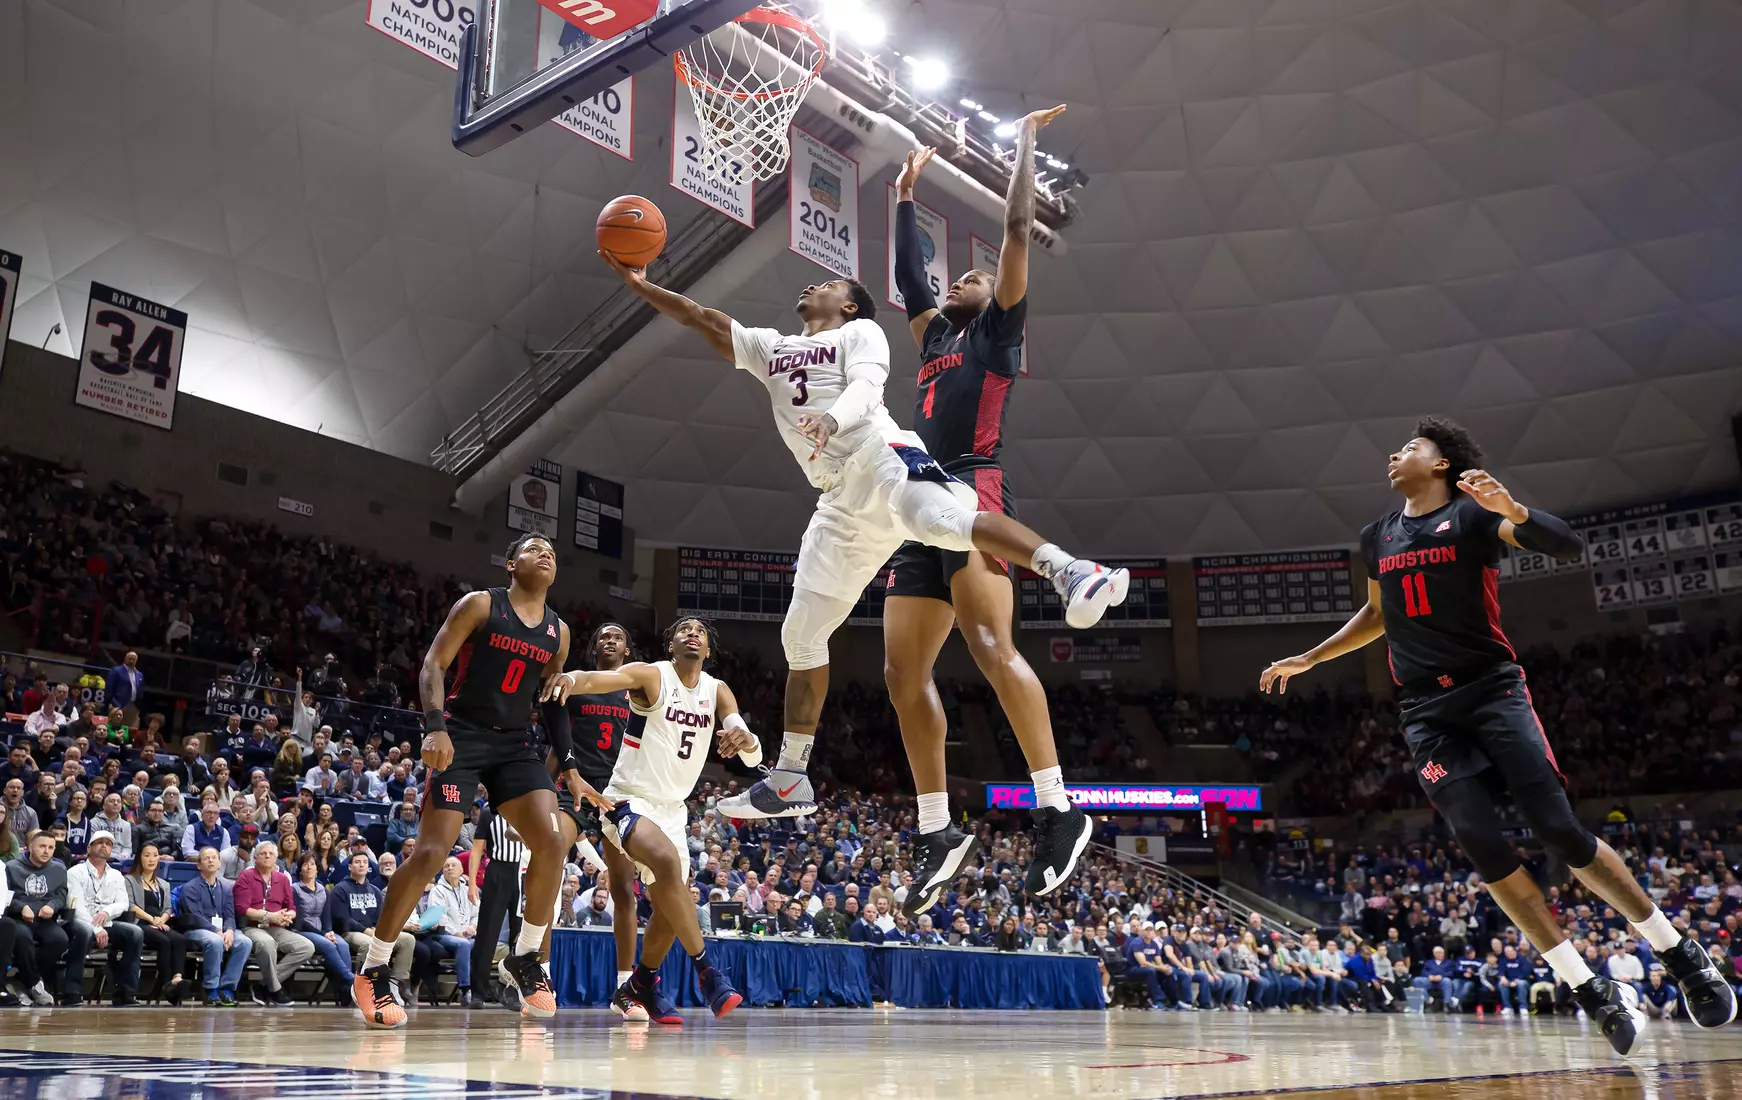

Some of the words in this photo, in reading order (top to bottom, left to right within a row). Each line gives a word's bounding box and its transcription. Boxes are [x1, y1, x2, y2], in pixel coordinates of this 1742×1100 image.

[391, 1, 458, 47] NATIONA
[382, 16, 459, 63] CHAMPION
[560, 111, 621, 149] AMPIONS
[573, 103, 616, 132] IONAL
[681, 177, 744, 218] CHAMPIONS
[686, 164, 741, 202] NATIONAL
[799, 201, 851, 247] 2014
[798, 241, 853, 277] CHAMPIONS
[802, 228, 849, 261] NATIONAL
[111, 292, 133, 308] RAY
[135, 300, 168, 320] ALLEN
[90, 309, 174, 391] 34
[768, 346, 837, 377] UCONN
[917, 352, 965, 386] OUSTON
[788, 368, 809, 407] 3
[922, 380, 936, 420] 4
[82, 389, 124, 405] NUMBER
[127, 401, 168, 419] RETIRED
[294, 502, 313, 514] 210
[1632, 536, 1660, 552] 44
[1714, 522, 1742, 540] 42
[681, 549, 701, 558] BIG
[707, 551, 738, 560] EAST
[744, 553, 797, 563] CONFERE
[1202, 558, 1236, 567] NCAA
[1242, 552, 1341, 565] CHAMPIONSHIP
[1379, 544, 1456, 575] HOUSTON
[1519, 554, 1544, 572] 22
[1594, 542, 1621, 559] 42
[1401, 571, 1432, 618] 11
[1600, 585, 1627, 603] 24
[1642, 580, 1664, 597] 13
[1681, 573, 1708, 592] 22
[489, 632, 553, 665] HOUSTON
[501, 658, 527, 694] 0
[81, 687, 105, 703] 08
[217, 702, 237, 714] SEC
[239, 703, 270, 722] 109
[581, 704, 629, 719] HOUSTON
[665, 706, 712, 728] UCONN
[597, 721, 613, 750] 3
[677, 730, 697, 760] 5
